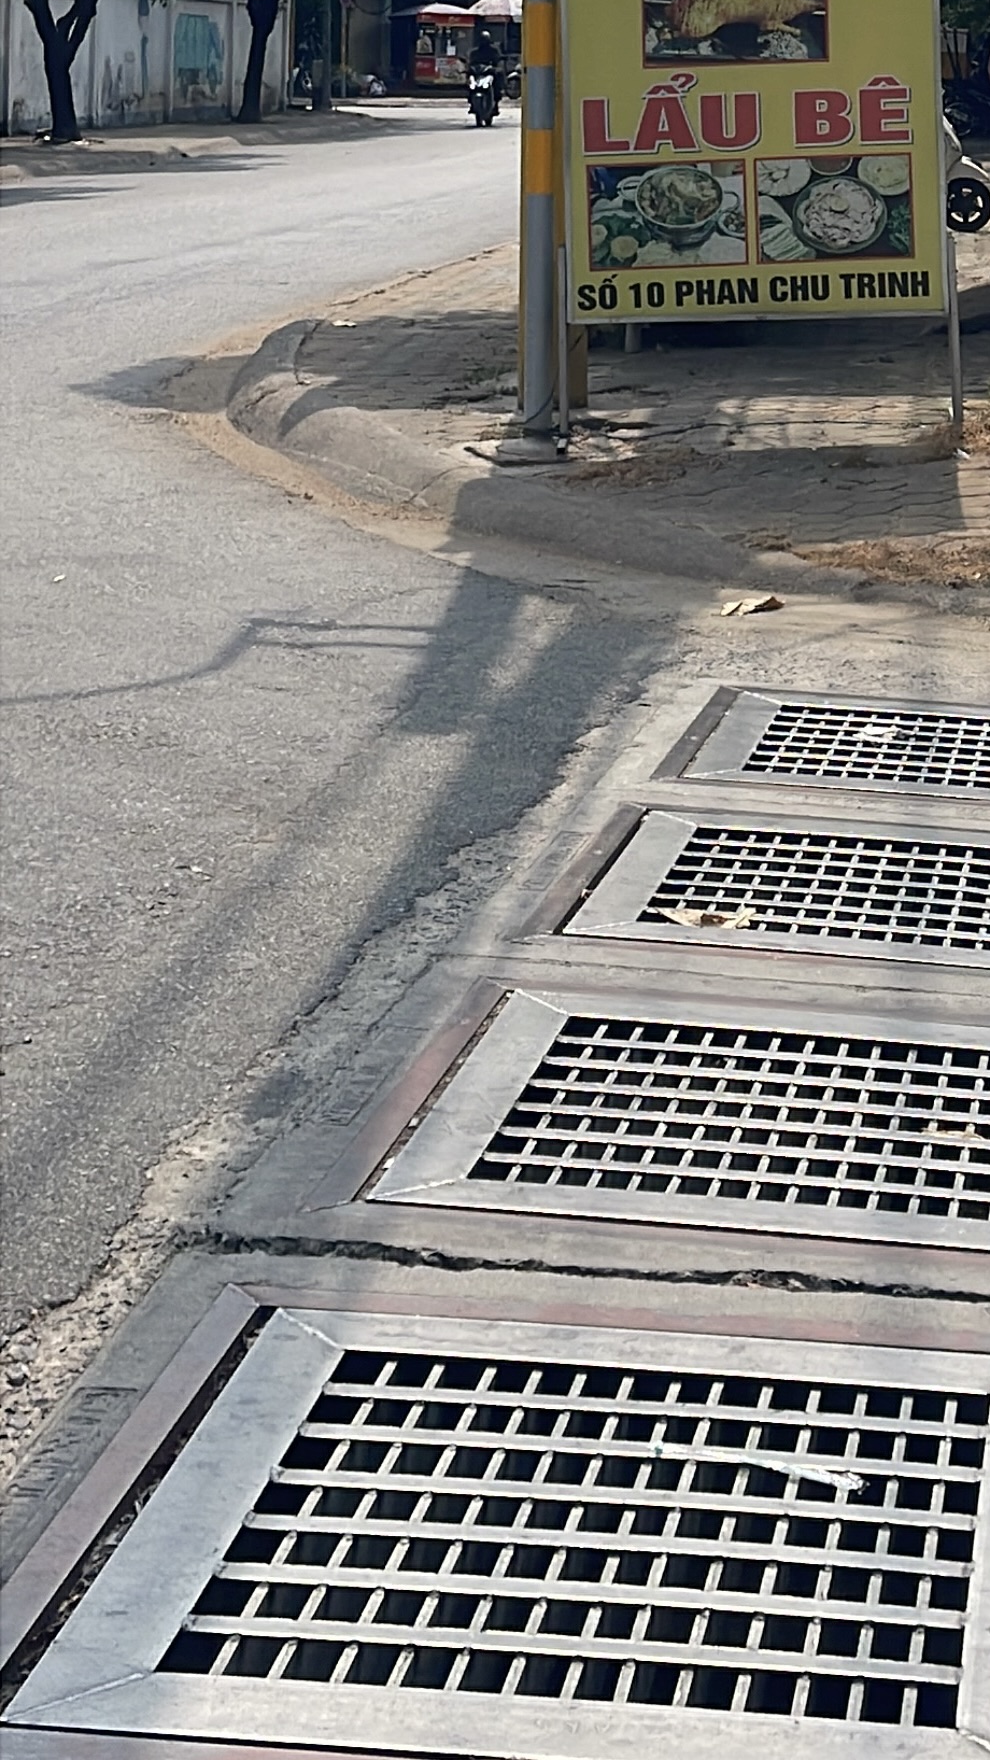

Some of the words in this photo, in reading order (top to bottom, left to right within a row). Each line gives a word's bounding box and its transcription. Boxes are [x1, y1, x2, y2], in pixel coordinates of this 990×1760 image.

[581, 73, 761, 156] LẨU
[793, 74, 914, 150] BÊ
[577, 274, 618, 311] SỐ
[629, 282, 665, 309] 10
[675, 277, 759, 307] PHAN
[769, 274, 829, 302] CHU
[839, 271, 930, 300] TRINH
